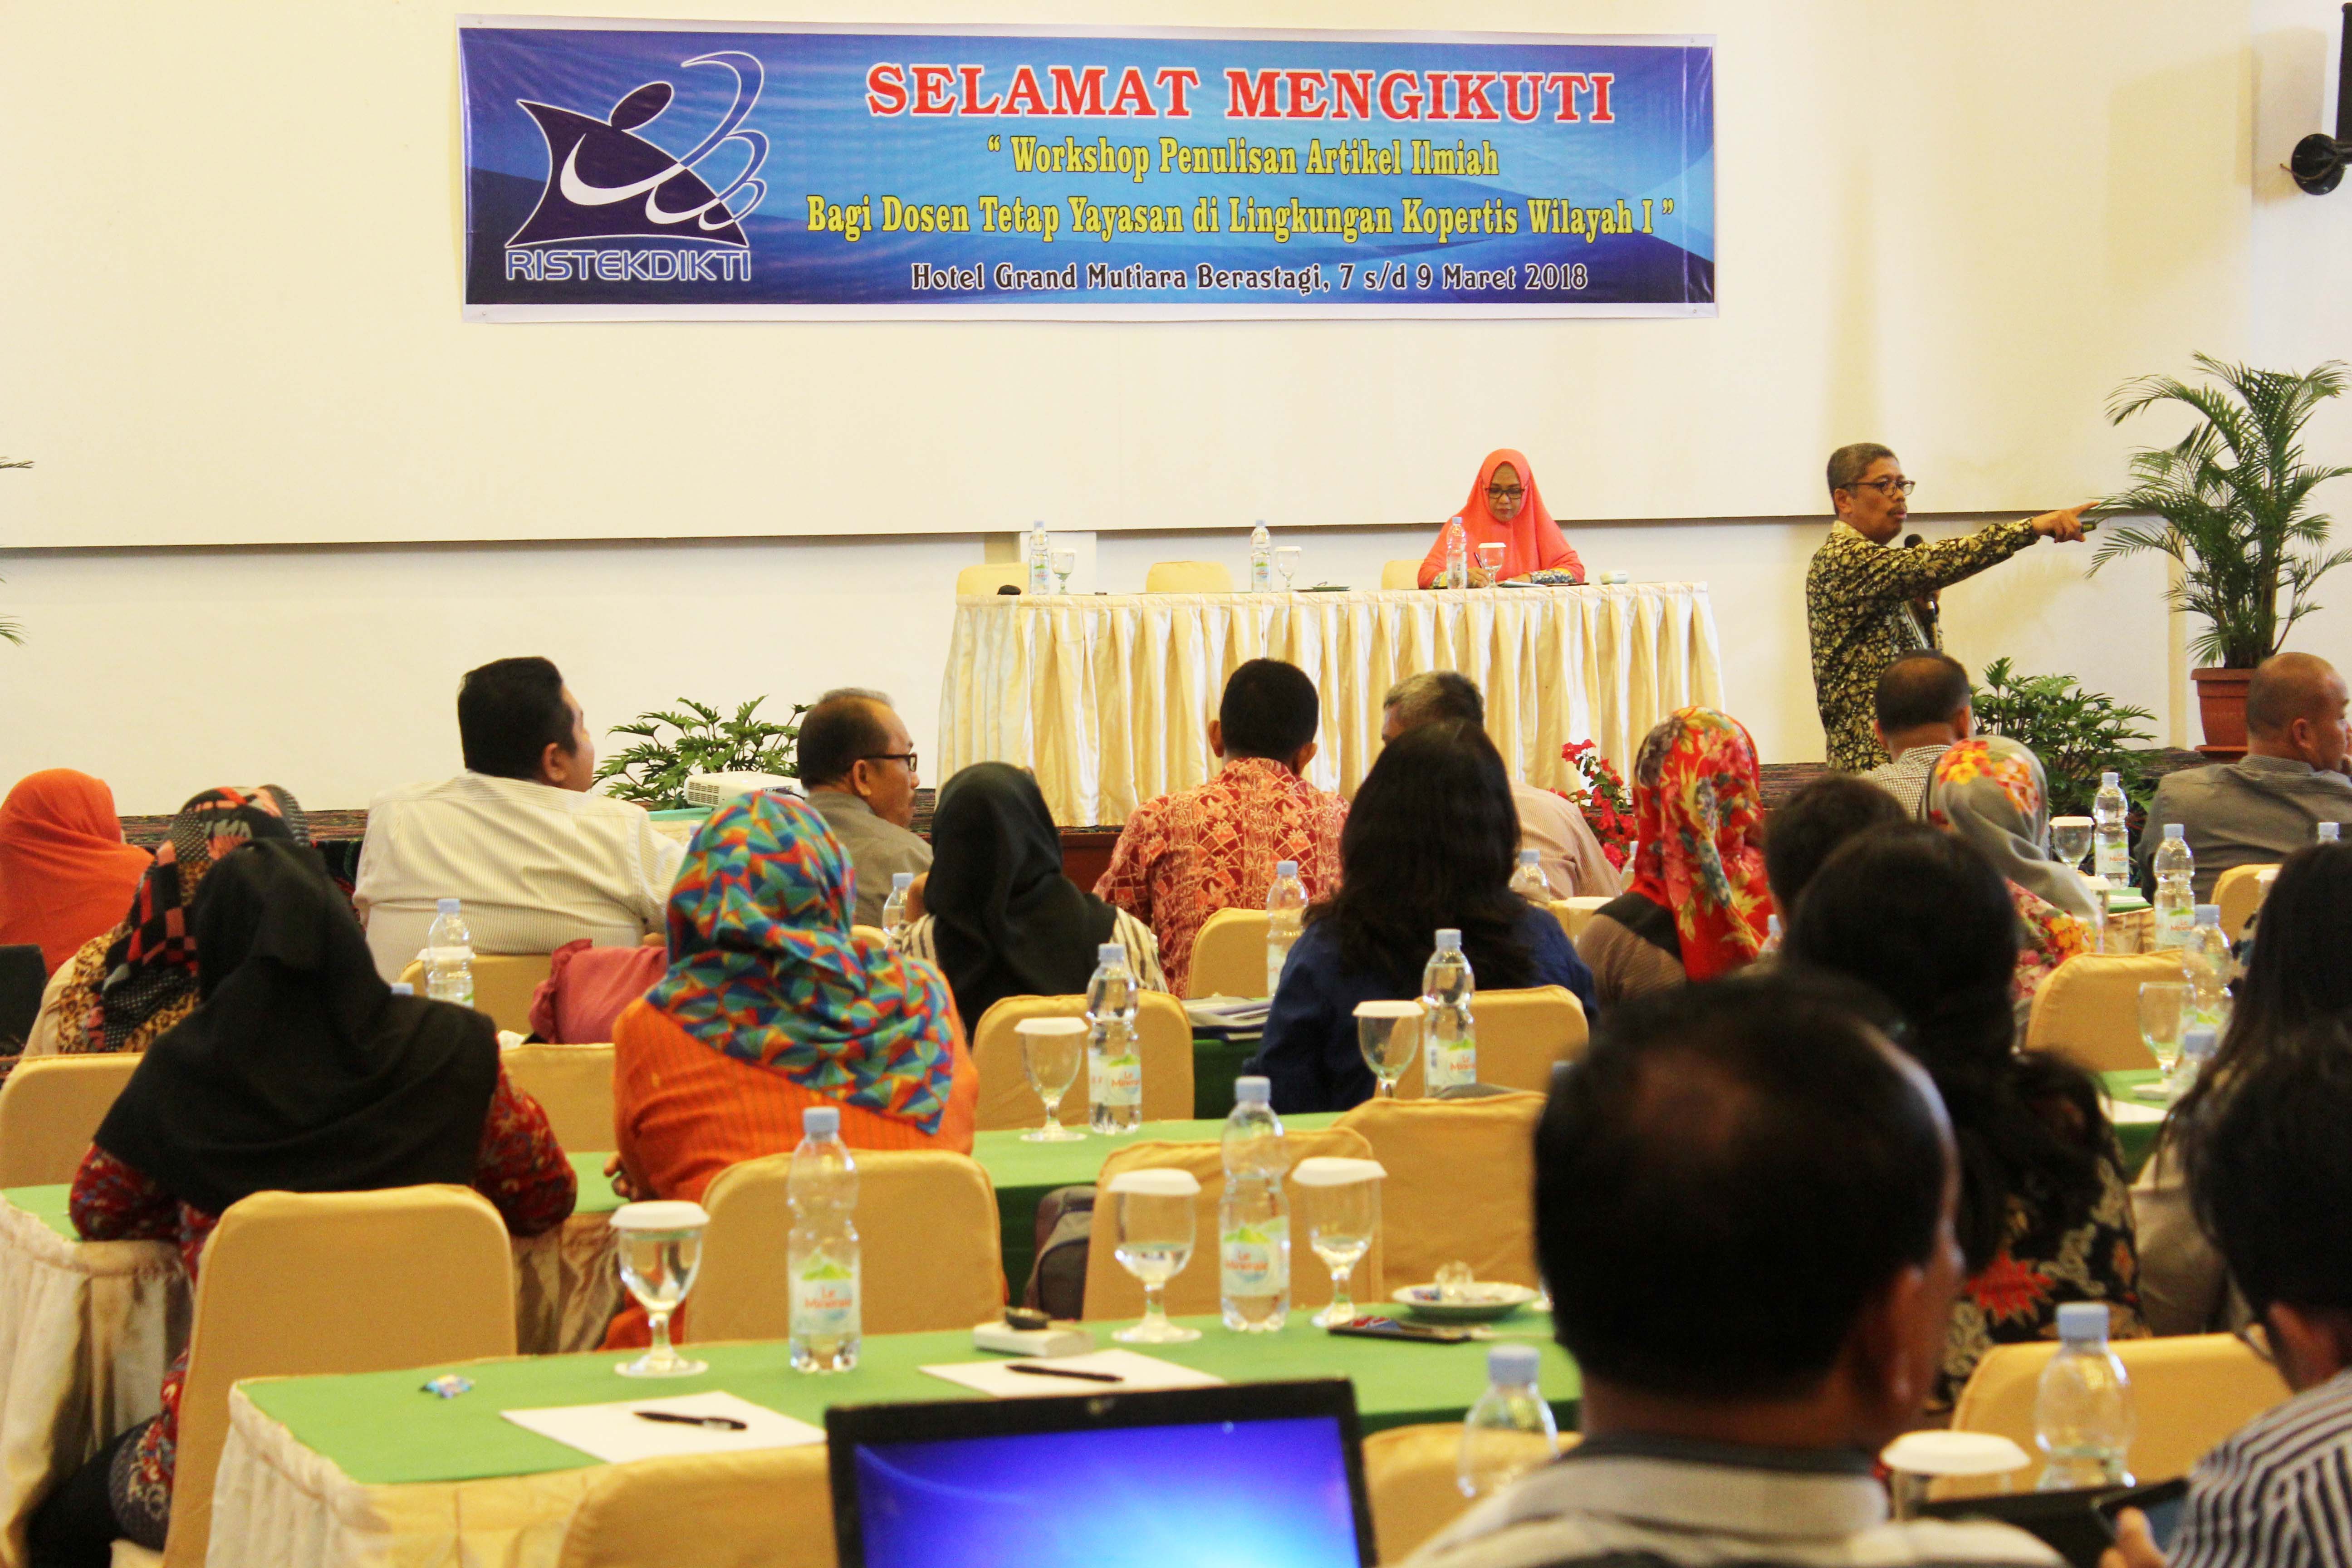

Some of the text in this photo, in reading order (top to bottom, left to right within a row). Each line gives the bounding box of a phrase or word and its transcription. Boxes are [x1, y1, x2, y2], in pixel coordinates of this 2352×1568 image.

[866, 62, 1614, 123] SELAMAT MENGIKUTI
[1010, 136, 1149, 182] Workshop
[1159, 137, 1297, 174] Penulisan
[1305, 138, 1402, 175] Artikel
[1411, 140, 1499, 176] Ilmiah
[807, 195, 872, 241] Bagi
[882, 196, 970, 233] Dosen
[979, 196, 1059, 242] Tetap
[1068, 196, 1184, 242] Yayasan
[1193, 196, 1220, 233] di
[1229, 196, 1393, 243] Lingkungan
[1401, 198, 1518, 243] Kopertis
[1527, 198, 1632, 243] Wilayah
[505, 250, 751, 280] RISTEKDIKTI
[911, 262, 1588, 295] Hotel Grand Mutiara Berastagi, 7 s/d 9 Maret 2018
